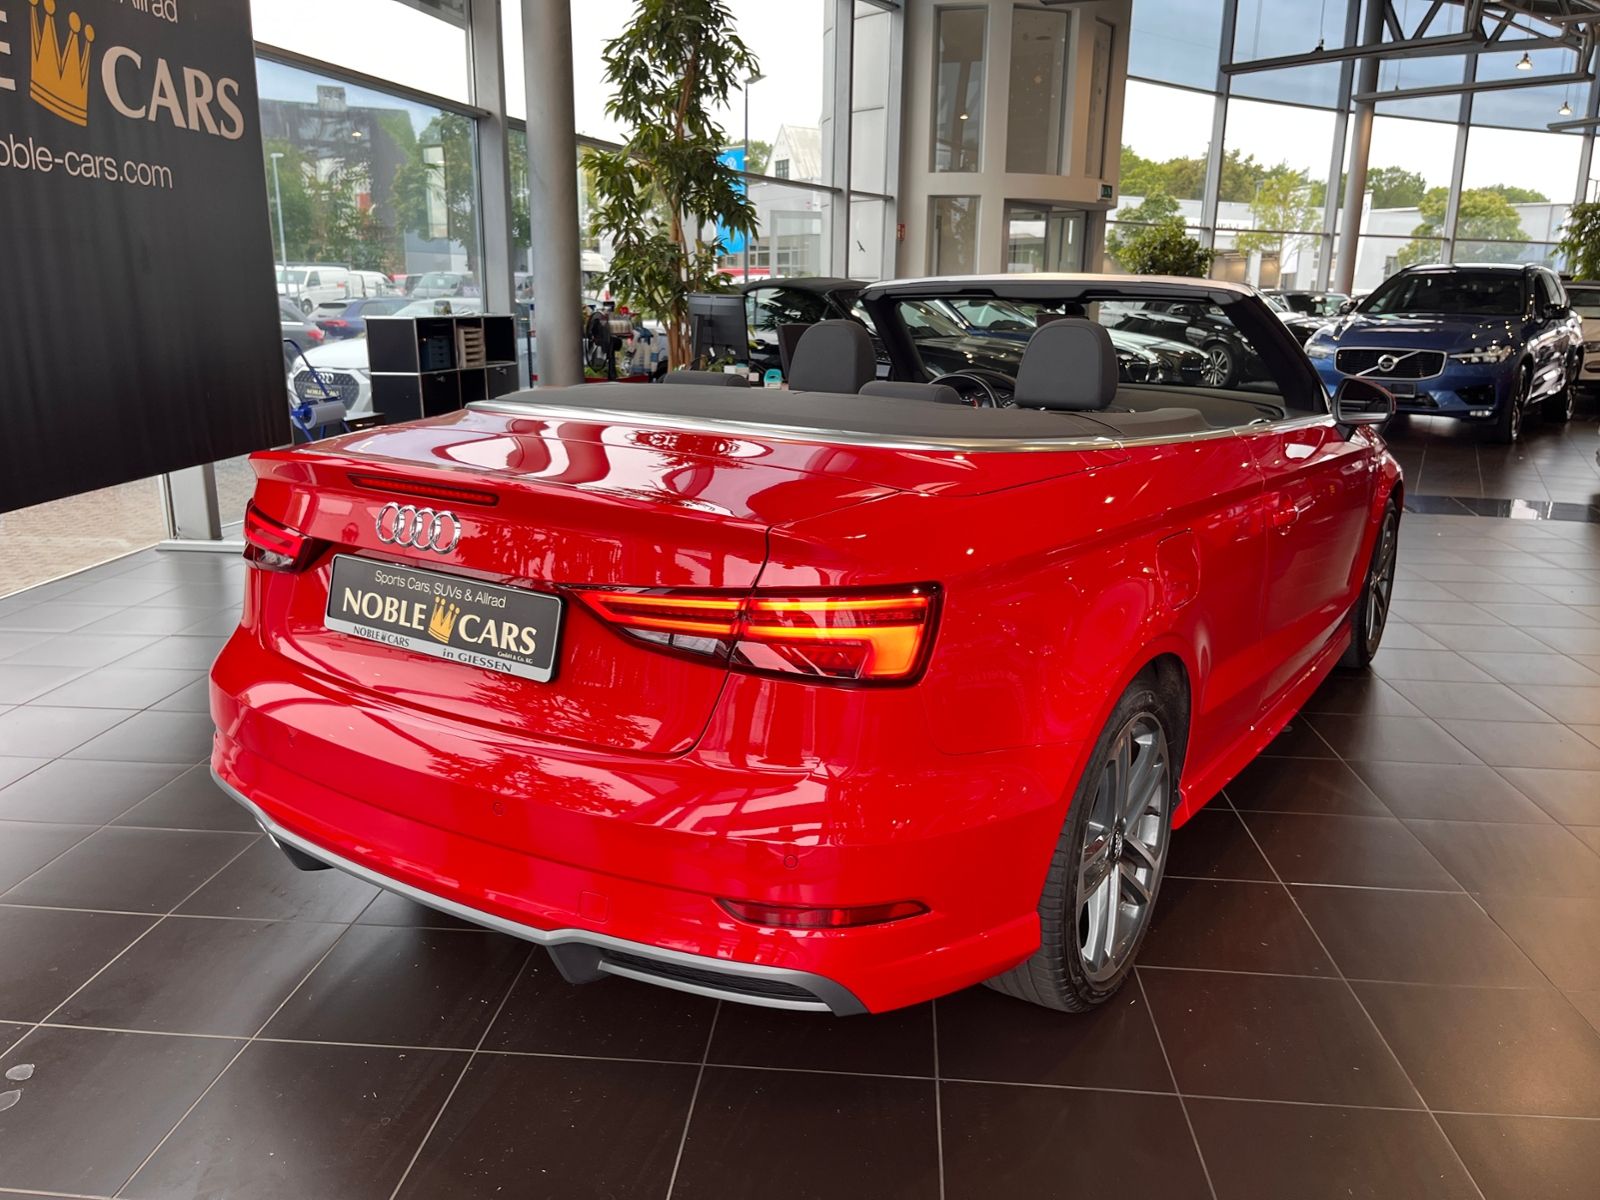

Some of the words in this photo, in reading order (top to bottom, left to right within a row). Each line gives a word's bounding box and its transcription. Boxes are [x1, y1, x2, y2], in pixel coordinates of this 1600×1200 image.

[101, 45, 244, 140] CARS
[375, 570, 406, 587] Sports
[407, 577, 433, 595] Cars,
[433, 582, 463, 600] SUVs
[464, 588, 473, 601] &
[475, 591, 507, 608] Allrad
[342, 587, 427, 631] NOBLE
[458, 614, 538, 655] CARS
[353, 625, 380, 639] NOBLE
[387, 634, 410, 647] CARS
[442, 648, 454, 659] in
[458, 652, 512, 672] GIESSEN
